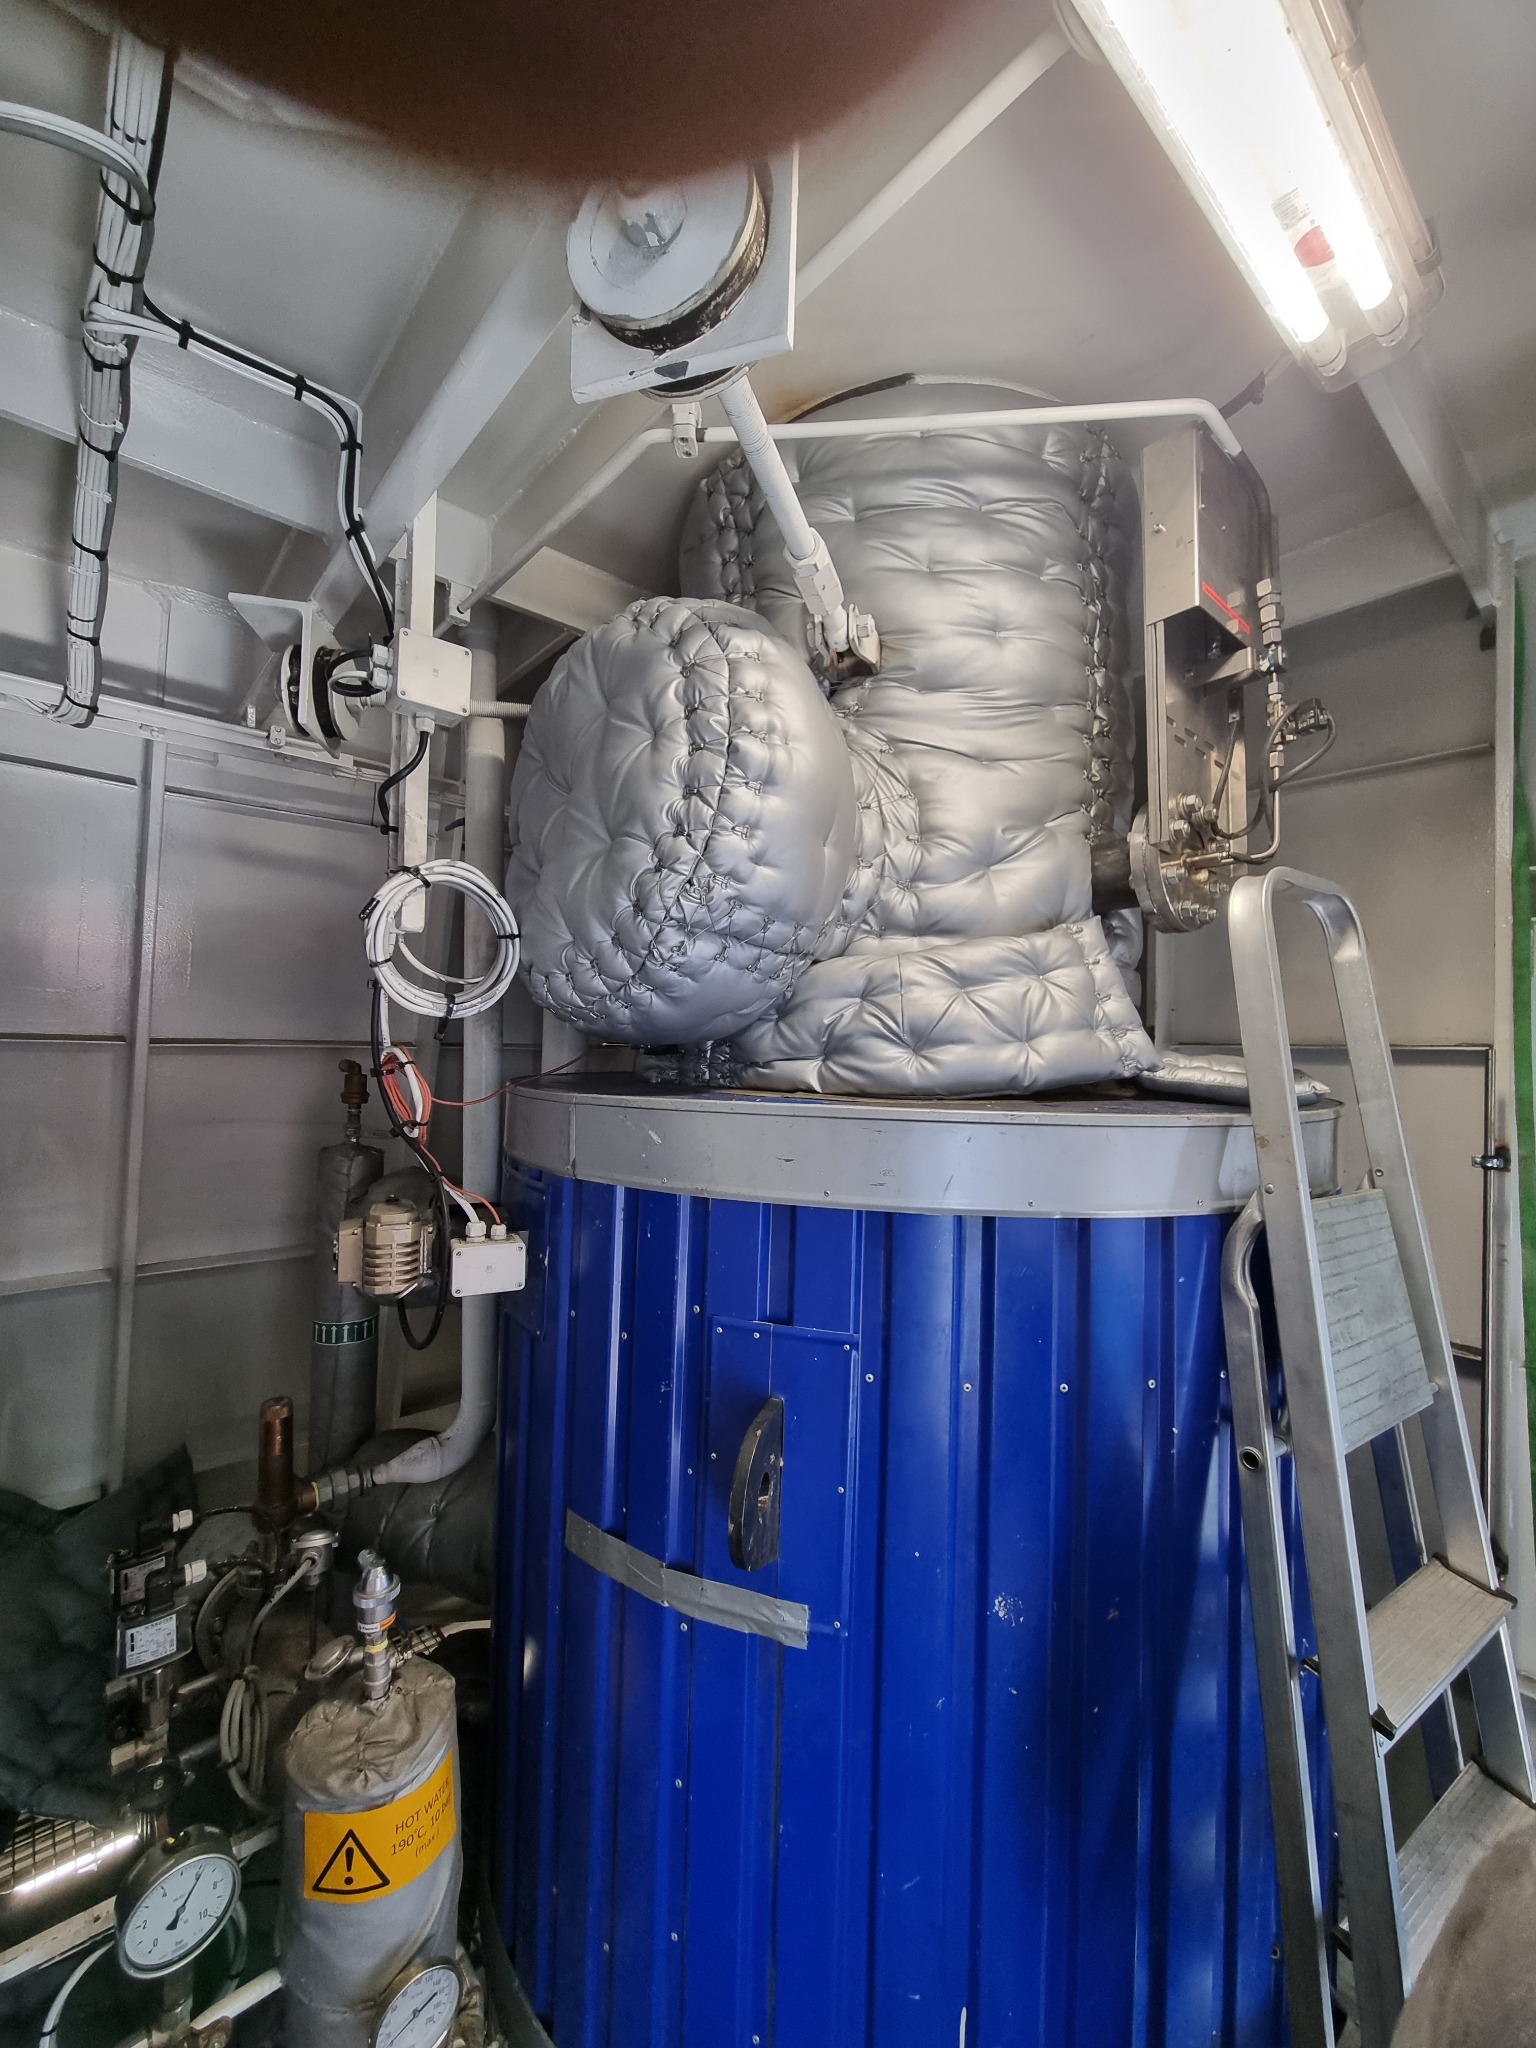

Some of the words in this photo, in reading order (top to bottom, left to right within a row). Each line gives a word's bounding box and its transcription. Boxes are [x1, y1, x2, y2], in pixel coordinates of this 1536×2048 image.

[395, 1809, 422, 1835] HOT
[424, 1776, 449, 1814] WATER
[391, 1825, 427, 1856] 190°C,
[431, 1809, 440, 1827] 10
[212, 1880, 218, 1890] 8
[199, 1908, 208, 1920] 10
[142, 1919, 148, 1930] 2
[152, 1937, 159, 1948] 0
